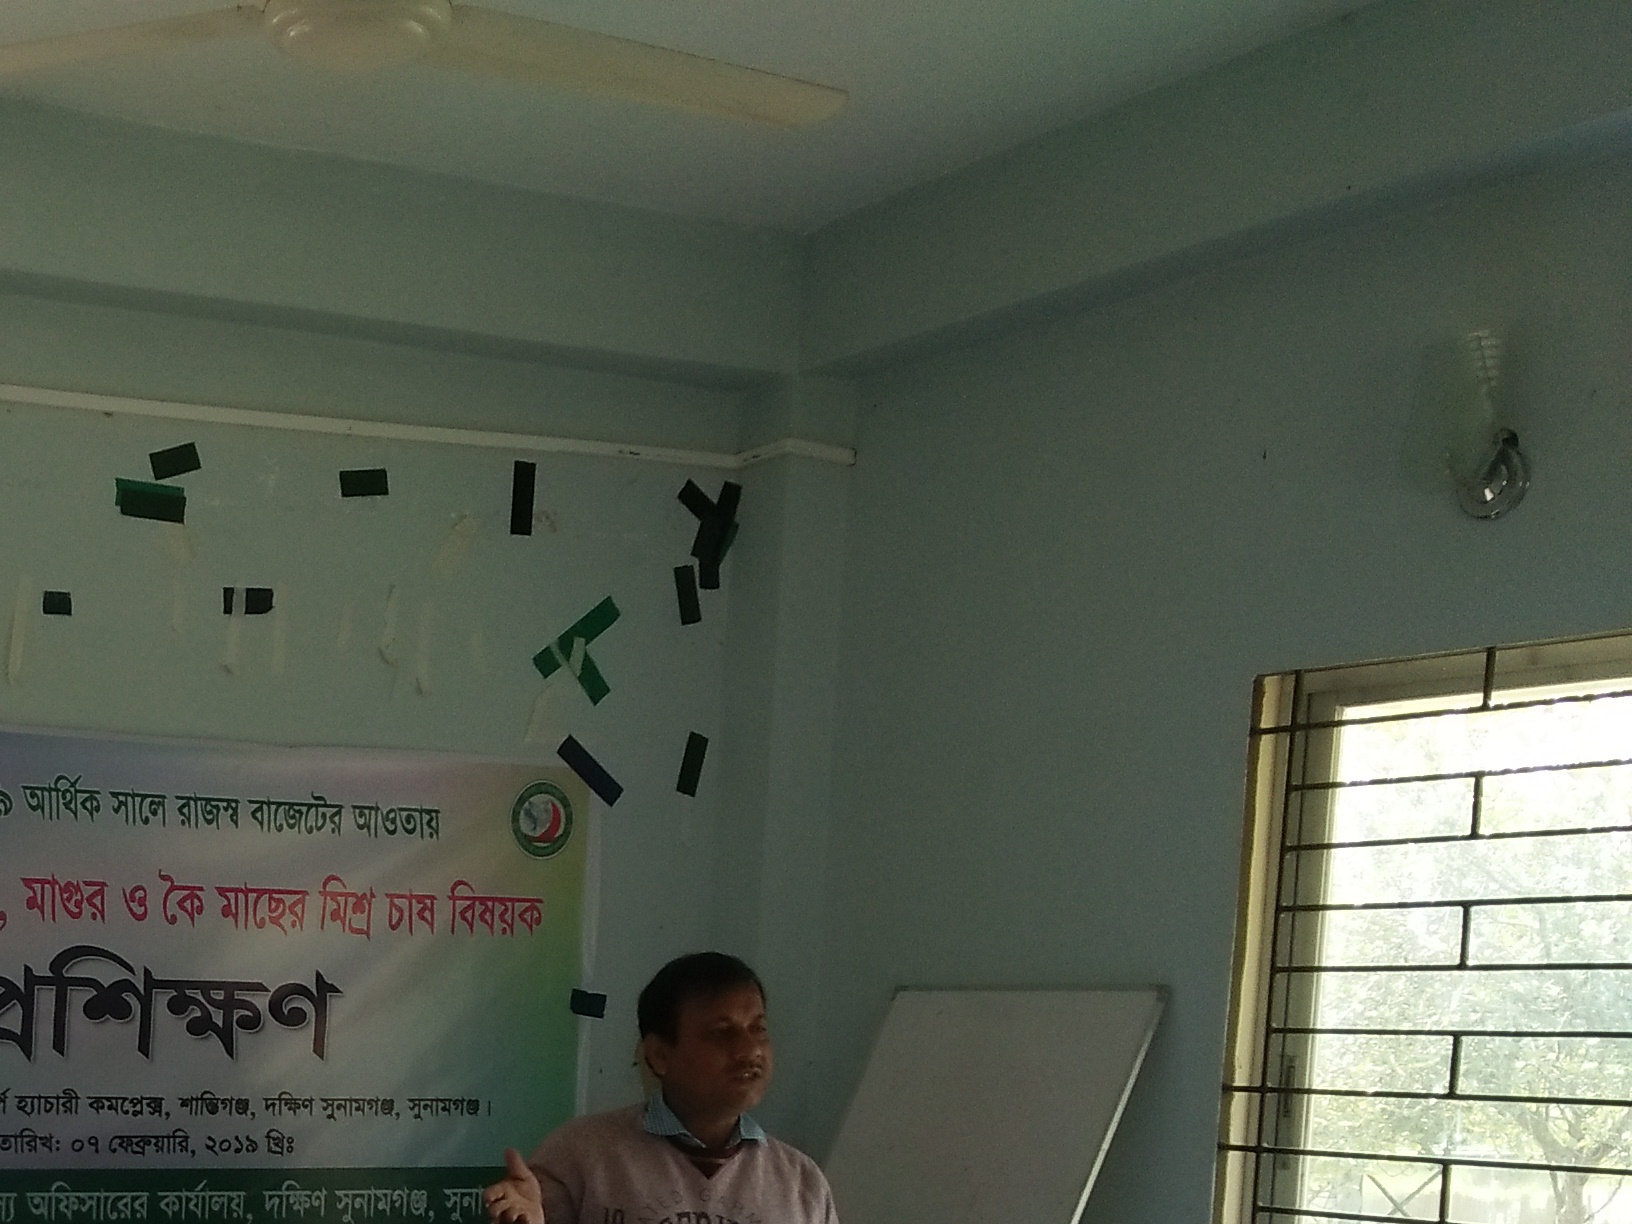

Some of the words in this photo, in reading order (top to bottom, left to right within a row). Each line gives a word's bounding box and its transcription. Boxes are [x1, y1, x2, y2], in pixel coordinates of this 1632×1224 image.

[21, 775, 101, 822] আর্থিক
[110, 788, 167, 827] সালে
[175, 792, 241, 832] রাজস্ব
[247, 791, 344, 838] বাজেটের
[352, 803, 441, 841] আওতায়
[20, 873, 108, 925] মাগুর
[122, 884, 149, 922] ও
[158, 869, 205, 928] কৈ
[215, 882, 308, 937] মাছের
[319, 874, 374, 941] মিশ্র
[386, 892, 438, 937] চাষ
[448, 879, 545, 937] বিষয়ক
[14, 1088, 80, 1119] হ্যাচারী
[88, 1096, 171, 1120] কমপ্লেক্স,
[263, 1089, 315, 1119] দক্ষিণ
[320, 1094, 401, 1121] সুনামগঞ্জ,
[71, 1135, 101, 1154] ০৭
[205, 1134, 258, 1156] ২০১৯
[25, 1180, 150, 1223] অফিসারের
[158, 1180, 254, 1224] কার্যালয়,
[263, 1180, 326, 1221] দক্ষিণ
